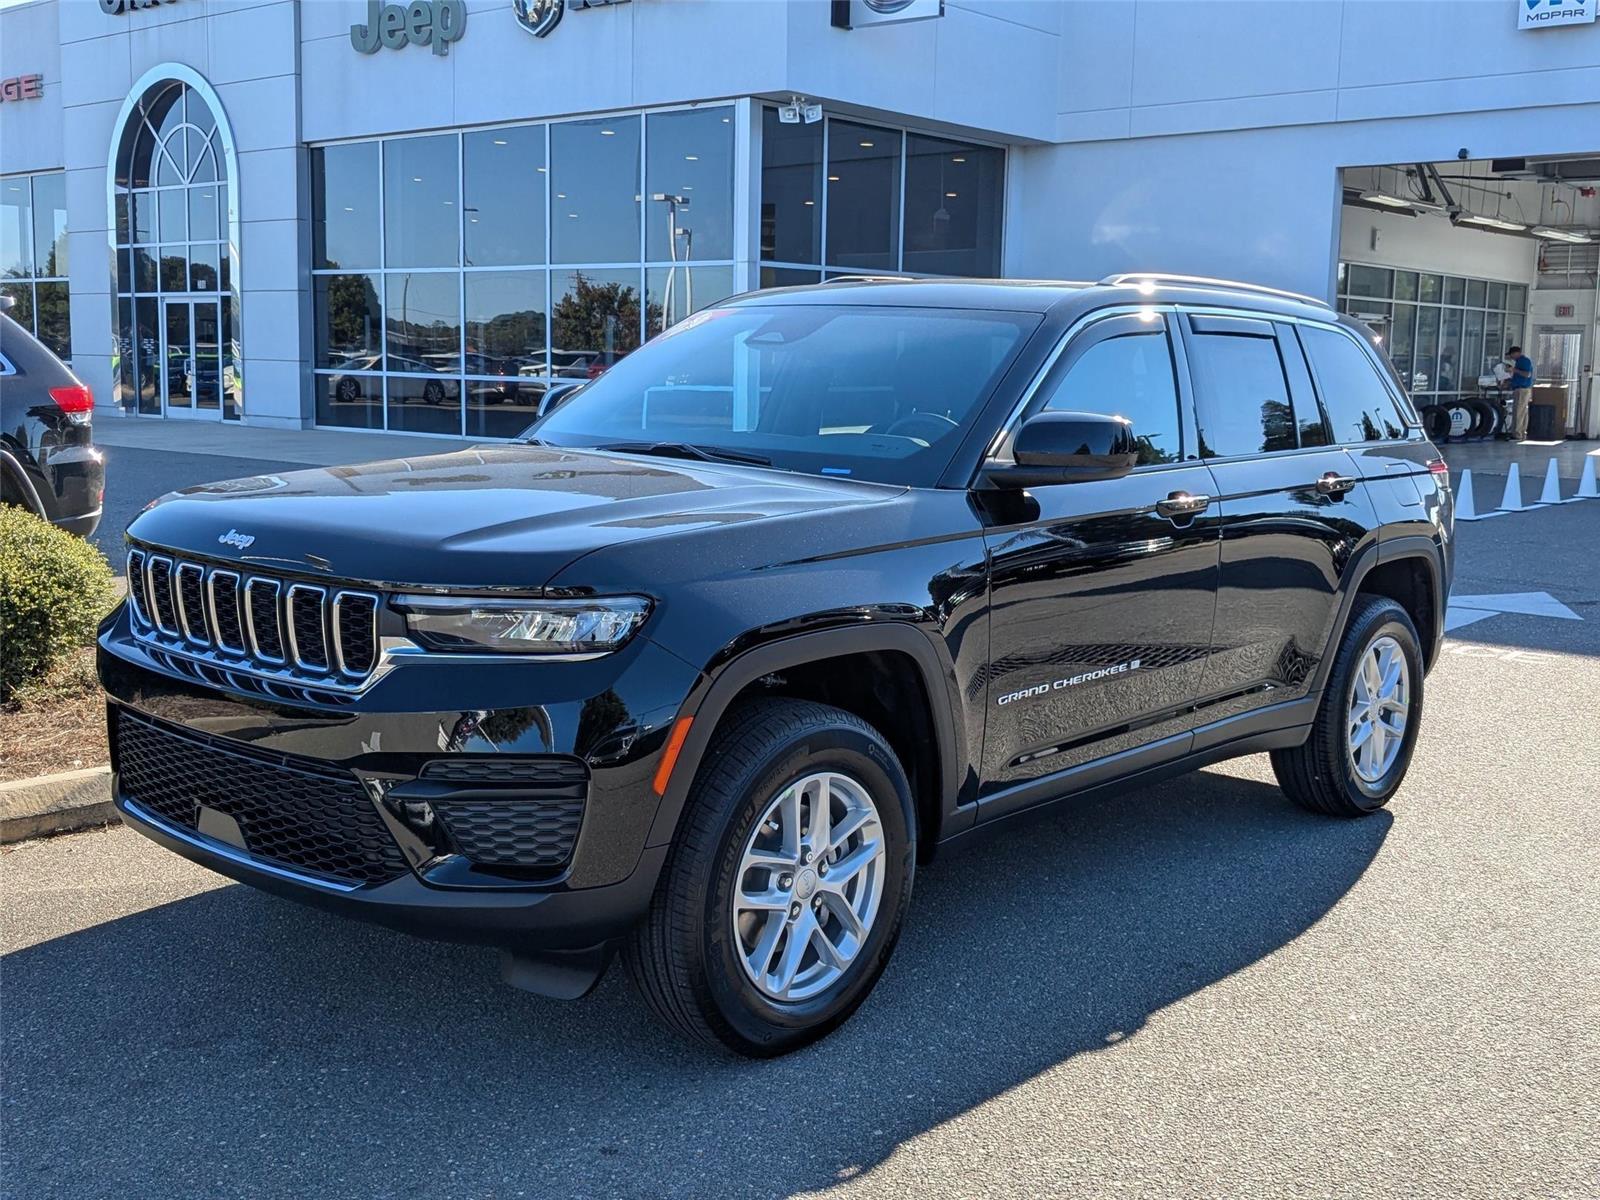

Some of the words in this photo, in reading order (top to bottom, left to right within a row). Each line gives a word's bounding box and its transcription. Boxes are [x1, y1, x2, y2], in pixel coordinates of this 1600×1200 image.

[350, 0, 467, 56] Jeep
[1526, 8, 1585, 22] MOPAR
[218, 528, 255, 550] Jeep
[997, 684, 1050, 706] GRAND
[1052, 663, 1128, 690] CHEROKEE
[716, 801, 754, 900] MICHELIN
